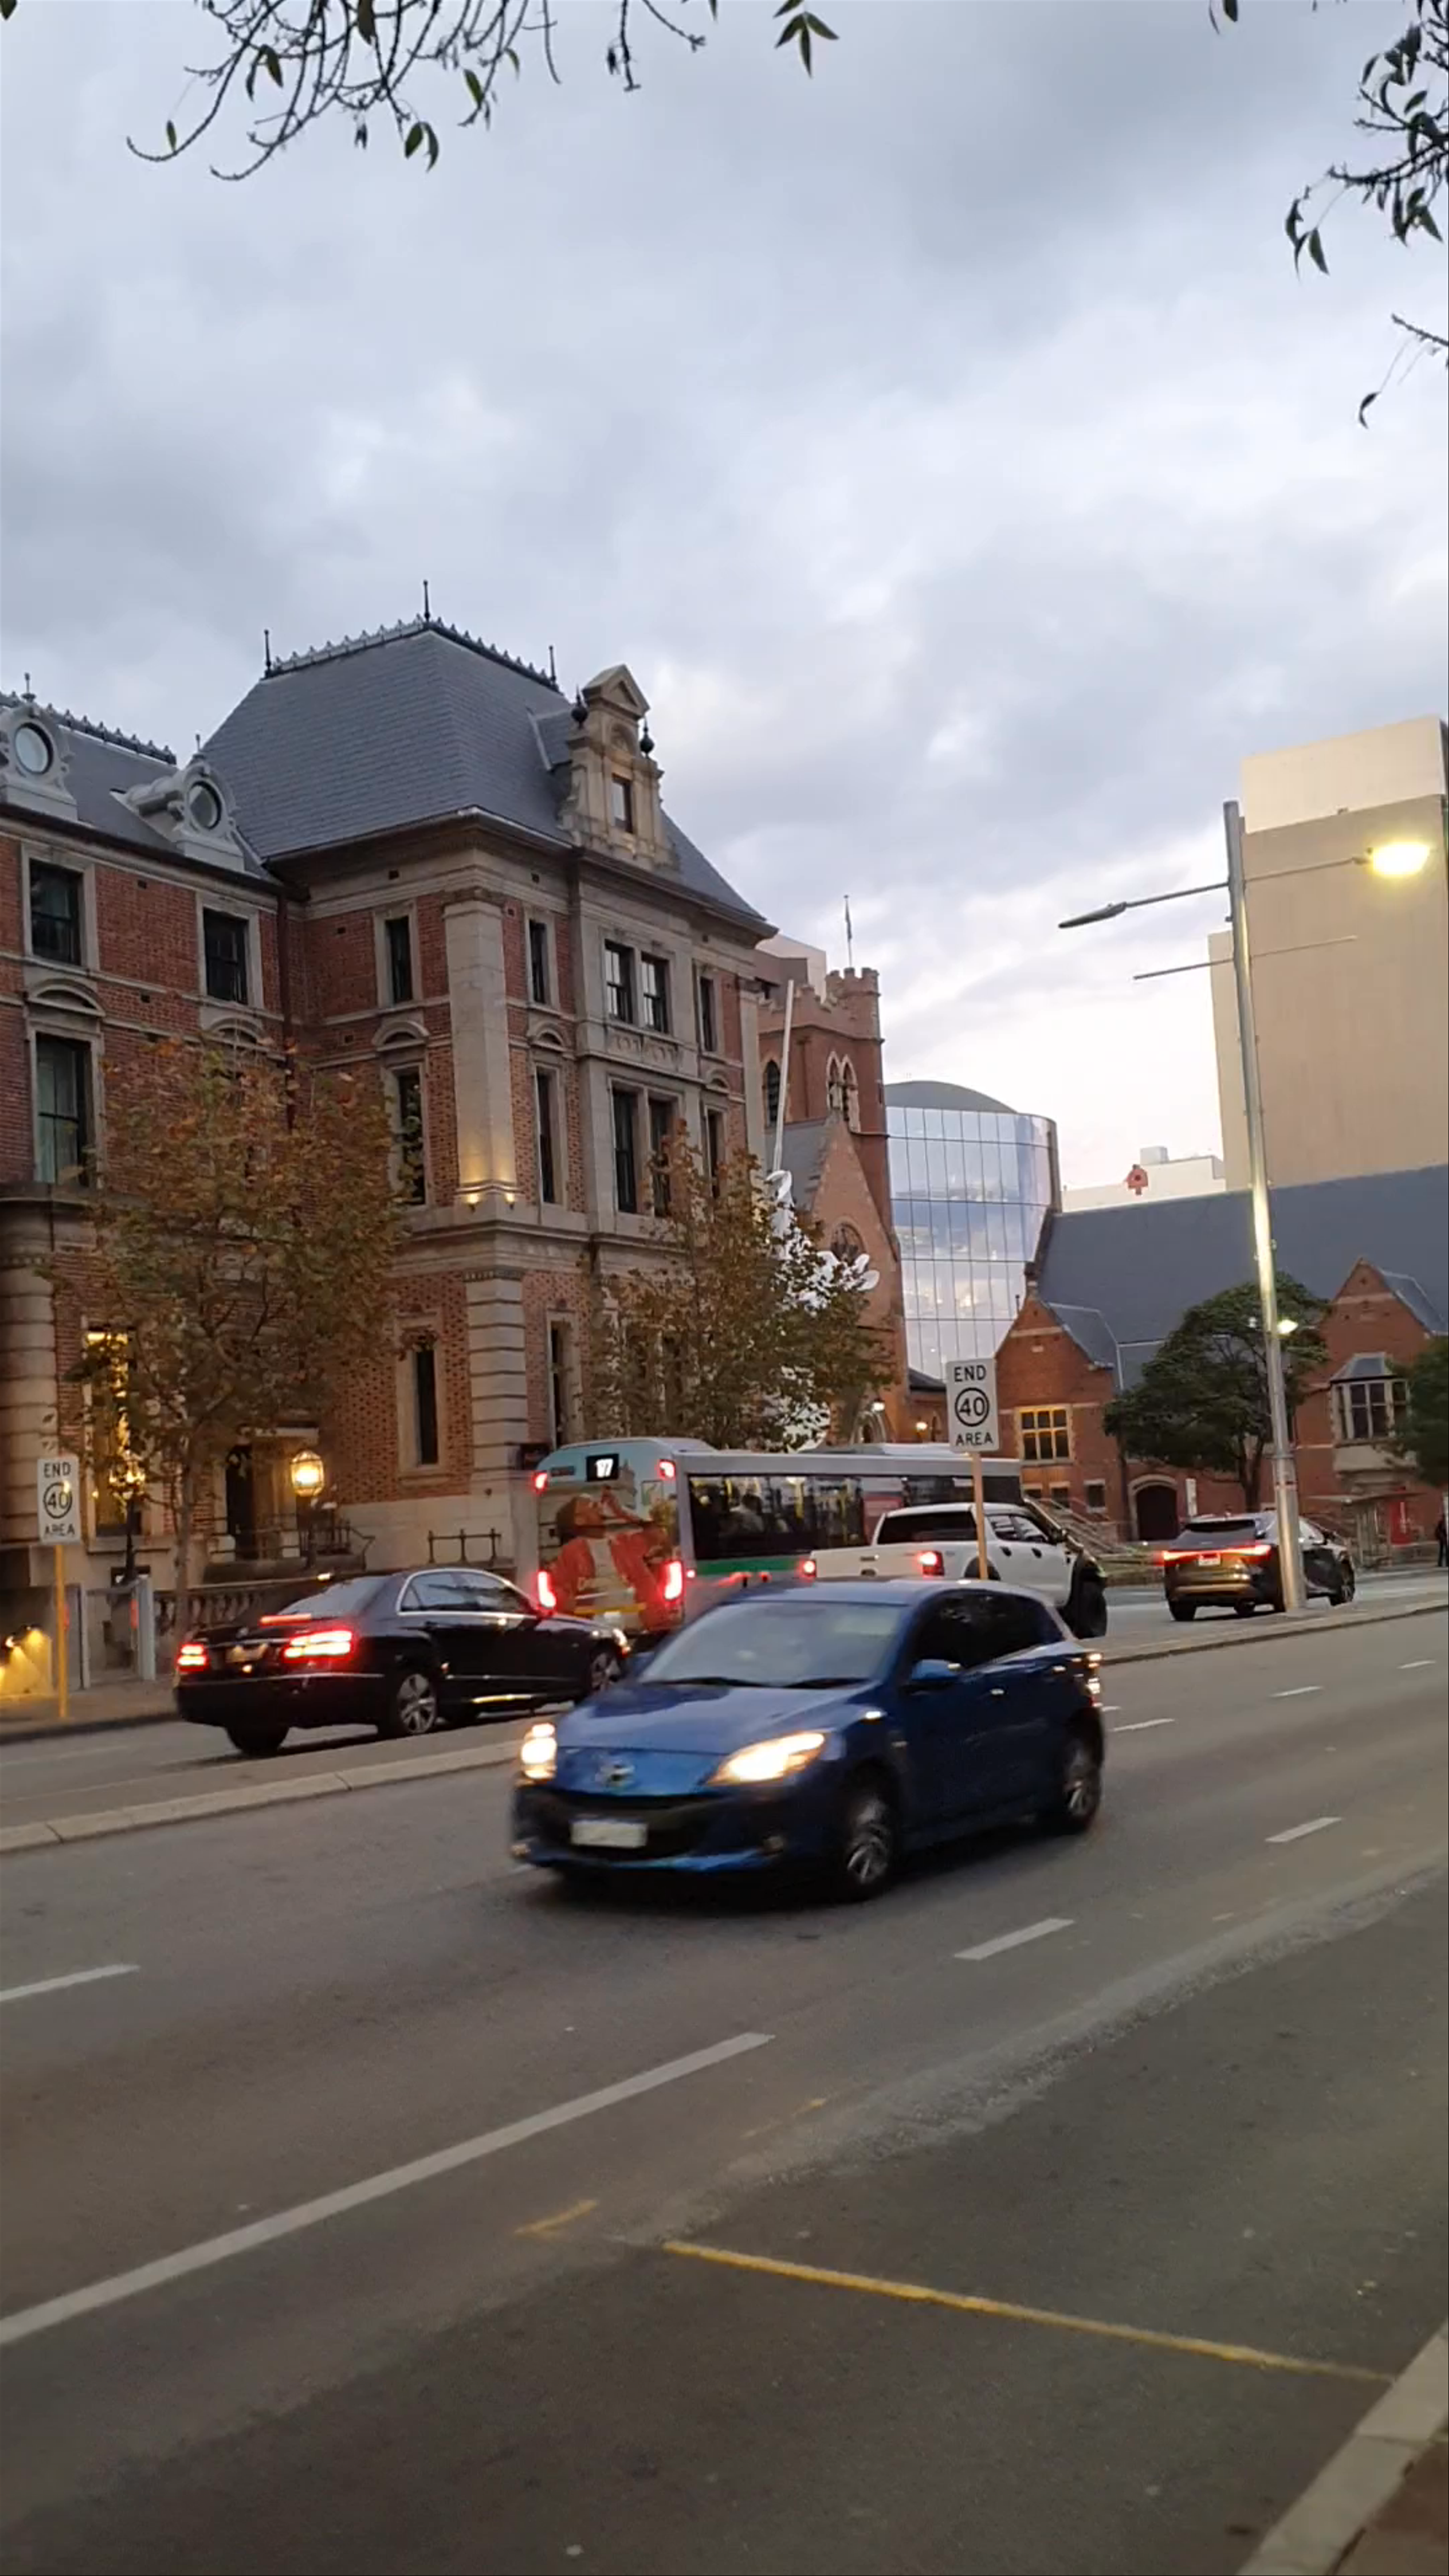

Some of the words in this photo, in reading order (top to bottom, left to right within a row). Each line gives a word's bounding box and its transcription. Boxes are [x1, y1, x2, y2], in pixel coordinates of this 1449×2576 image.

[954, 1364, 986, 1382] END
[959, 1396, 985, 1416] 40
[955, 1432, 993, 1446] AREA
[43, 1462, 71, 1478] END
[47, 1490, 69, 1509] 40
